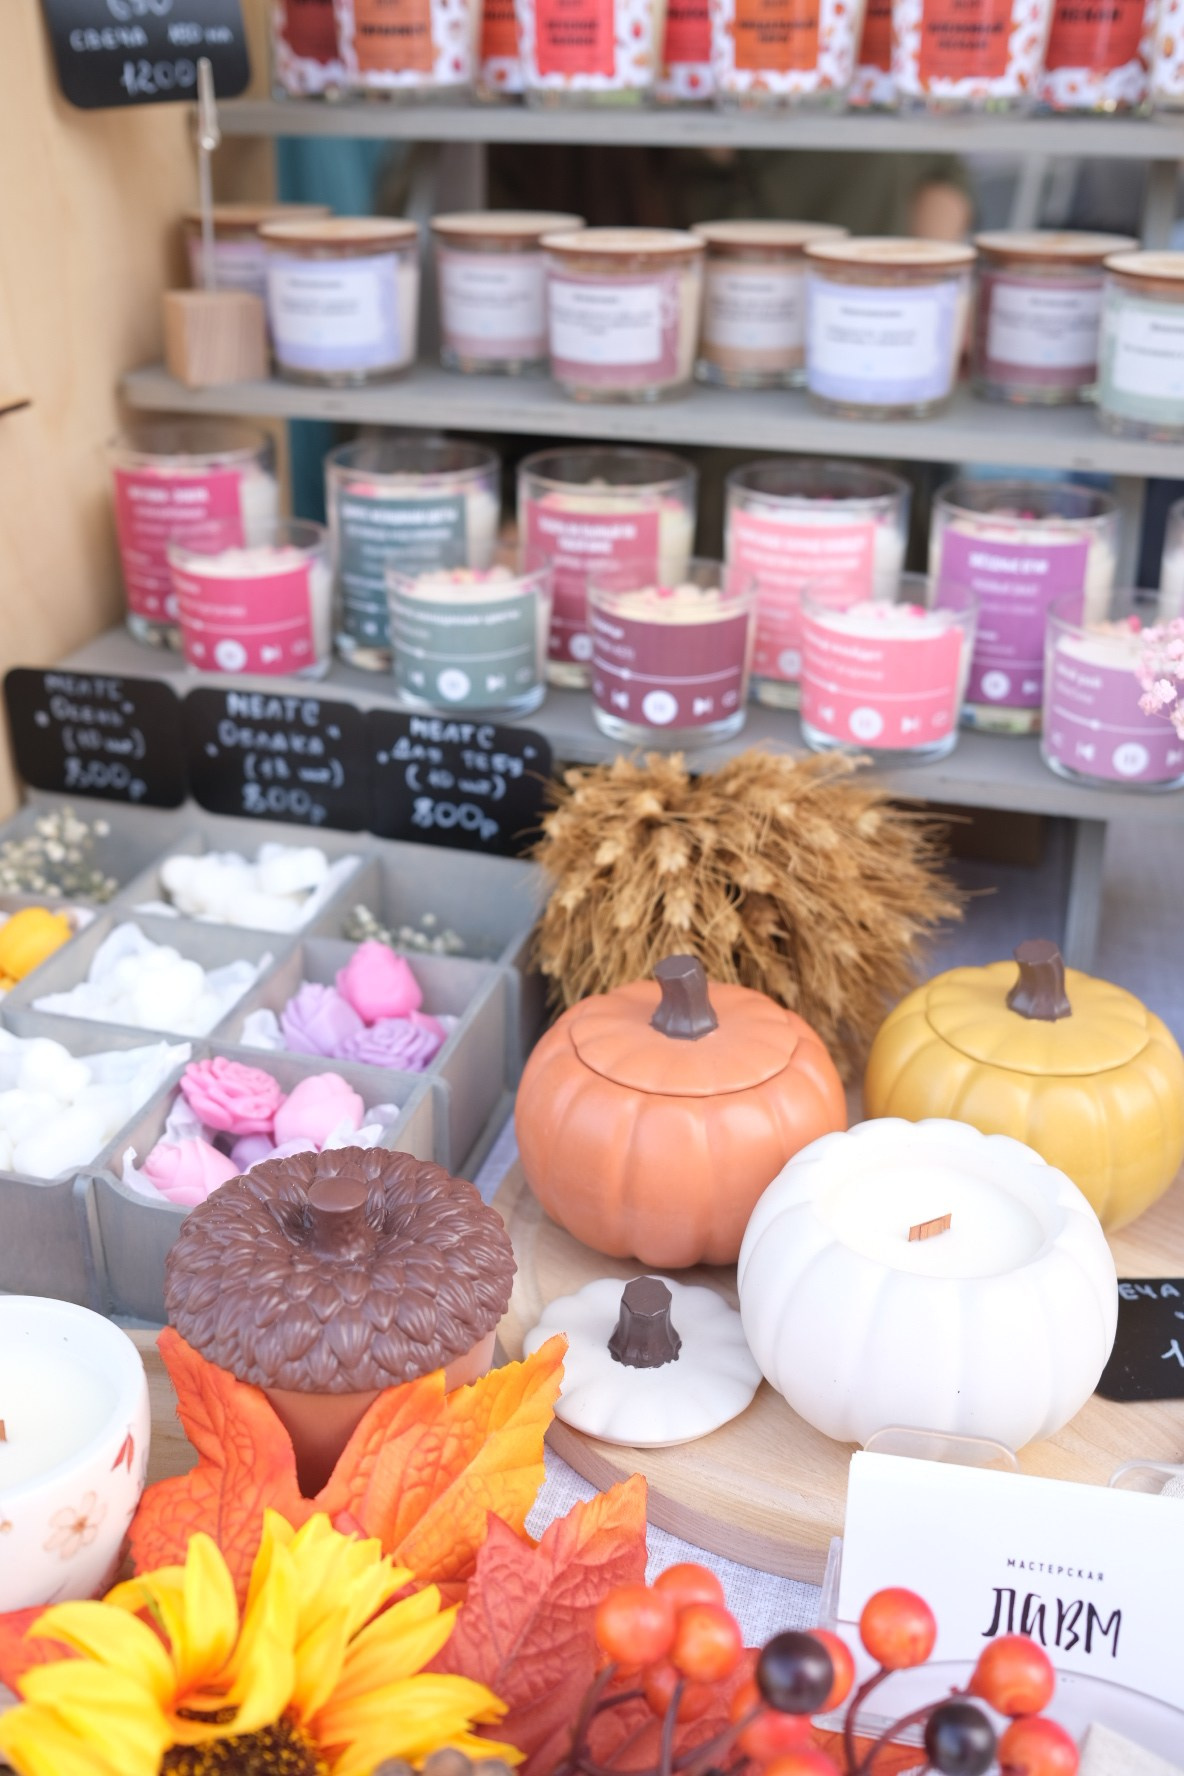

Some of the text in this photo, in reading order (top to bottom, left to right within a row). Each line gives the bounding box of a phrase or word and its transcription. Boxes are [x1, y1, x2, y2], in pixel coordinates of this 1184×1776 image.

[70, 25, 148, 51] СВЕЧА
[120, 58, 197, 96] 1200
[1117, 1283, 1180, 1300] ЕЧА
[1007, 1558, 1105, 1581] МАСТЕРСКАЯ
